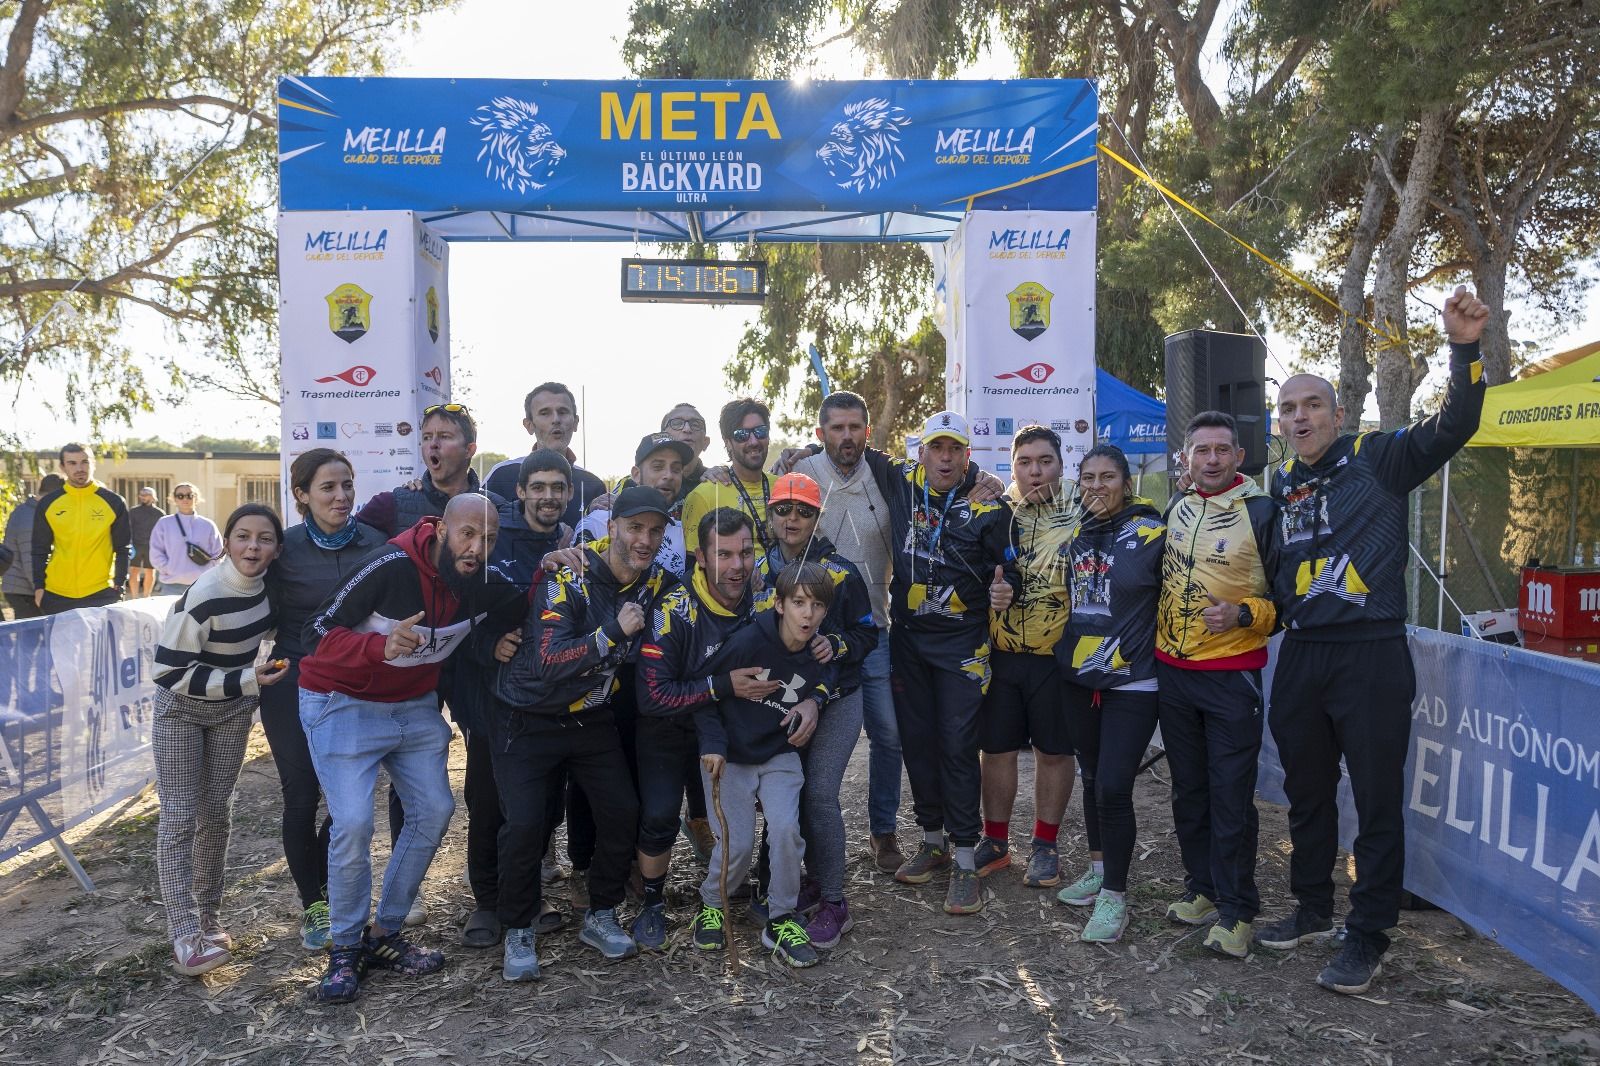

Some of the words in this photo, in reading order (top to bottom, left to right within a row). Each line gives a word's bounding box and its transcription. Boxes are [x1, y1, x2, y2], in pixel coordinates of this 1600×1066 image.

[601, 92, 782, 140] META
[343, 126, 447, 154] MELILLA
[935, 126, 1036, 154] MELILLA
[343, 154, 379, 165] CIUDAD
[382, 154, 400, 164] DEL
[402, 154, 442, 165] DEPORTE
[641, 151, 655, 161] EL
[660, 149, 706, 161] ÚLTIMO
[712, 149, 743, 161] LEÓN
[936, 154, 970, 165] CIUDAD
[972, 154, 990, 164] DEL
[993, 154, 1031, 165] DEPORTE
[622, 162, 762, 191] BACKYARD
[676, 193, 708, 203] ULTRA
[305, 229, 388, 253] MELILLA
[989, 228, 1071, 251] MELILLA
[301, 390, 400, 399] Trasmediterránea
[983, 386, 1079, 395] Trasmediterránea
[1499, 404, 1573, 425] CORREDORES
[1411, 692, 1448, 728] AD
